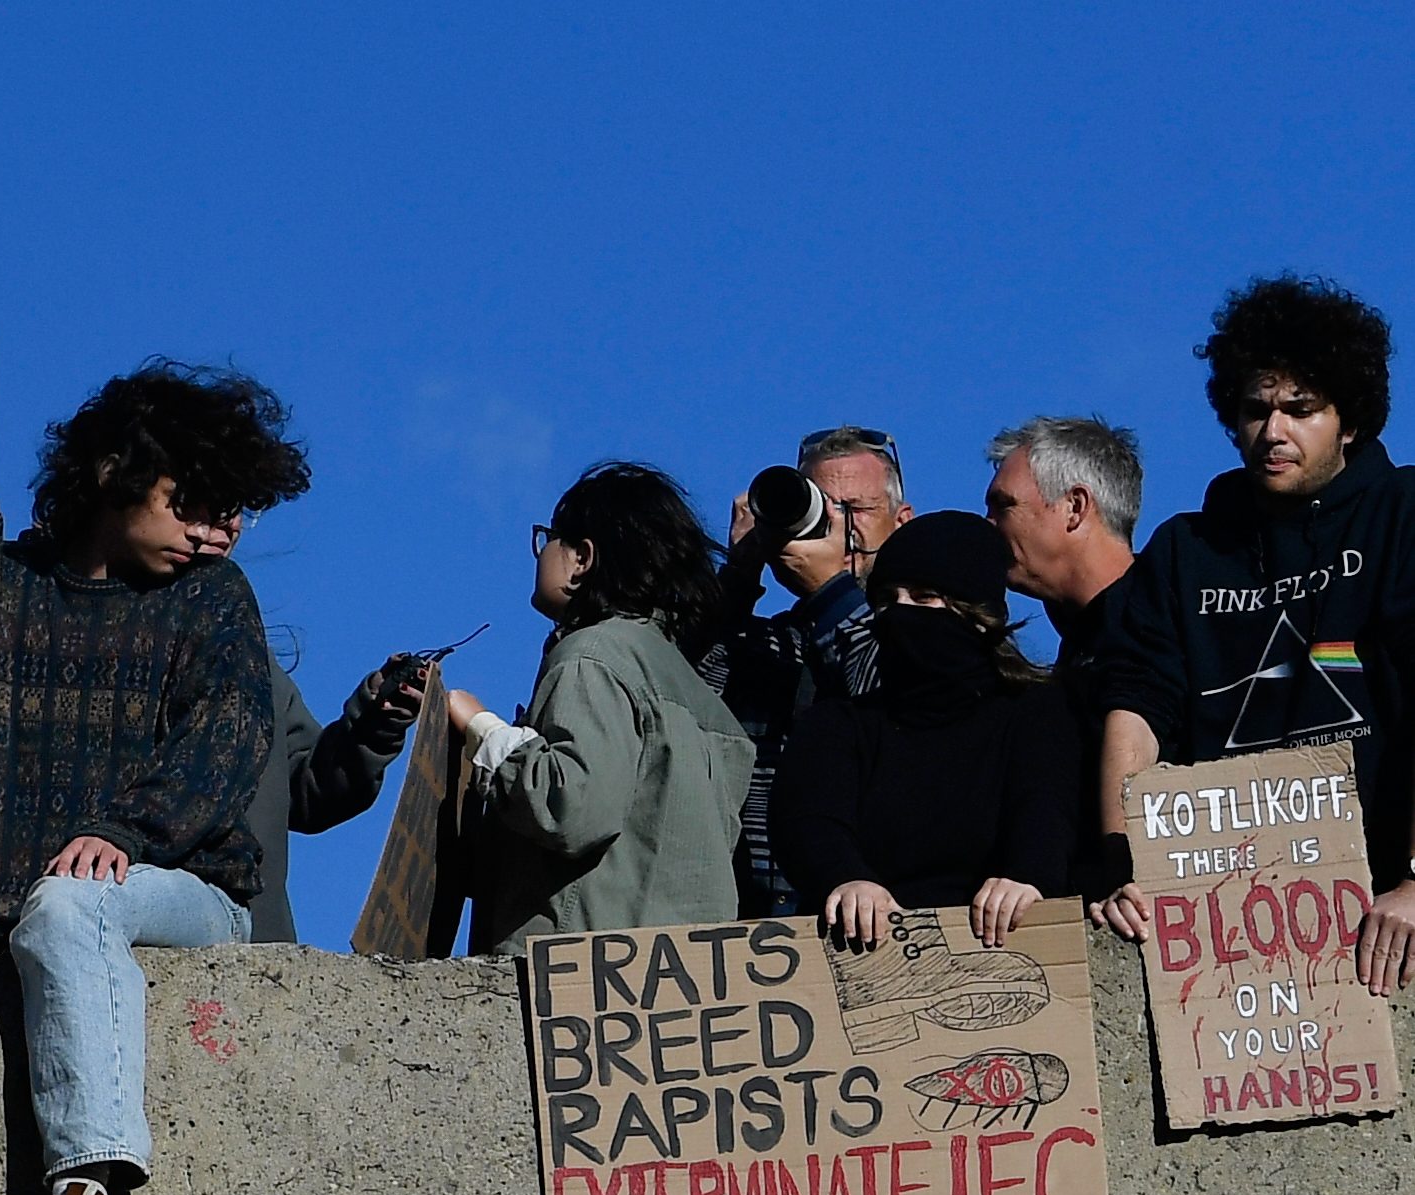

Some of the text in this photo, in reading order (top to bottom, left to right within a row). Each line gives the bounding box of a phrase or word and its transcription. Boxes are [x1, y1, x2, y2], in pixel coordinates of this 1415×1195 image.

[1198, 549, 1363, 614] PINK FLOD
[1308, 733, 1333, 747] THE
[1335, 725, 1371, 741] MOON
[1141, 774, 1354, 840] KOTLIKOFF,
[1168, 837, 1321, 879] THERE IS
[1153, 877, 1372, 973] BLOOD
[532, 921, 802, 1018] FRATS
[1235, 978, 1300, 1019] ON
[540, 999, 816, 1093] BREED
[1217, 1020, 1321, 1060] YOUR
[548, 1064, 883, 1167] RAPISTS
[1202, 1062, 1380, 1116] HANDS!
